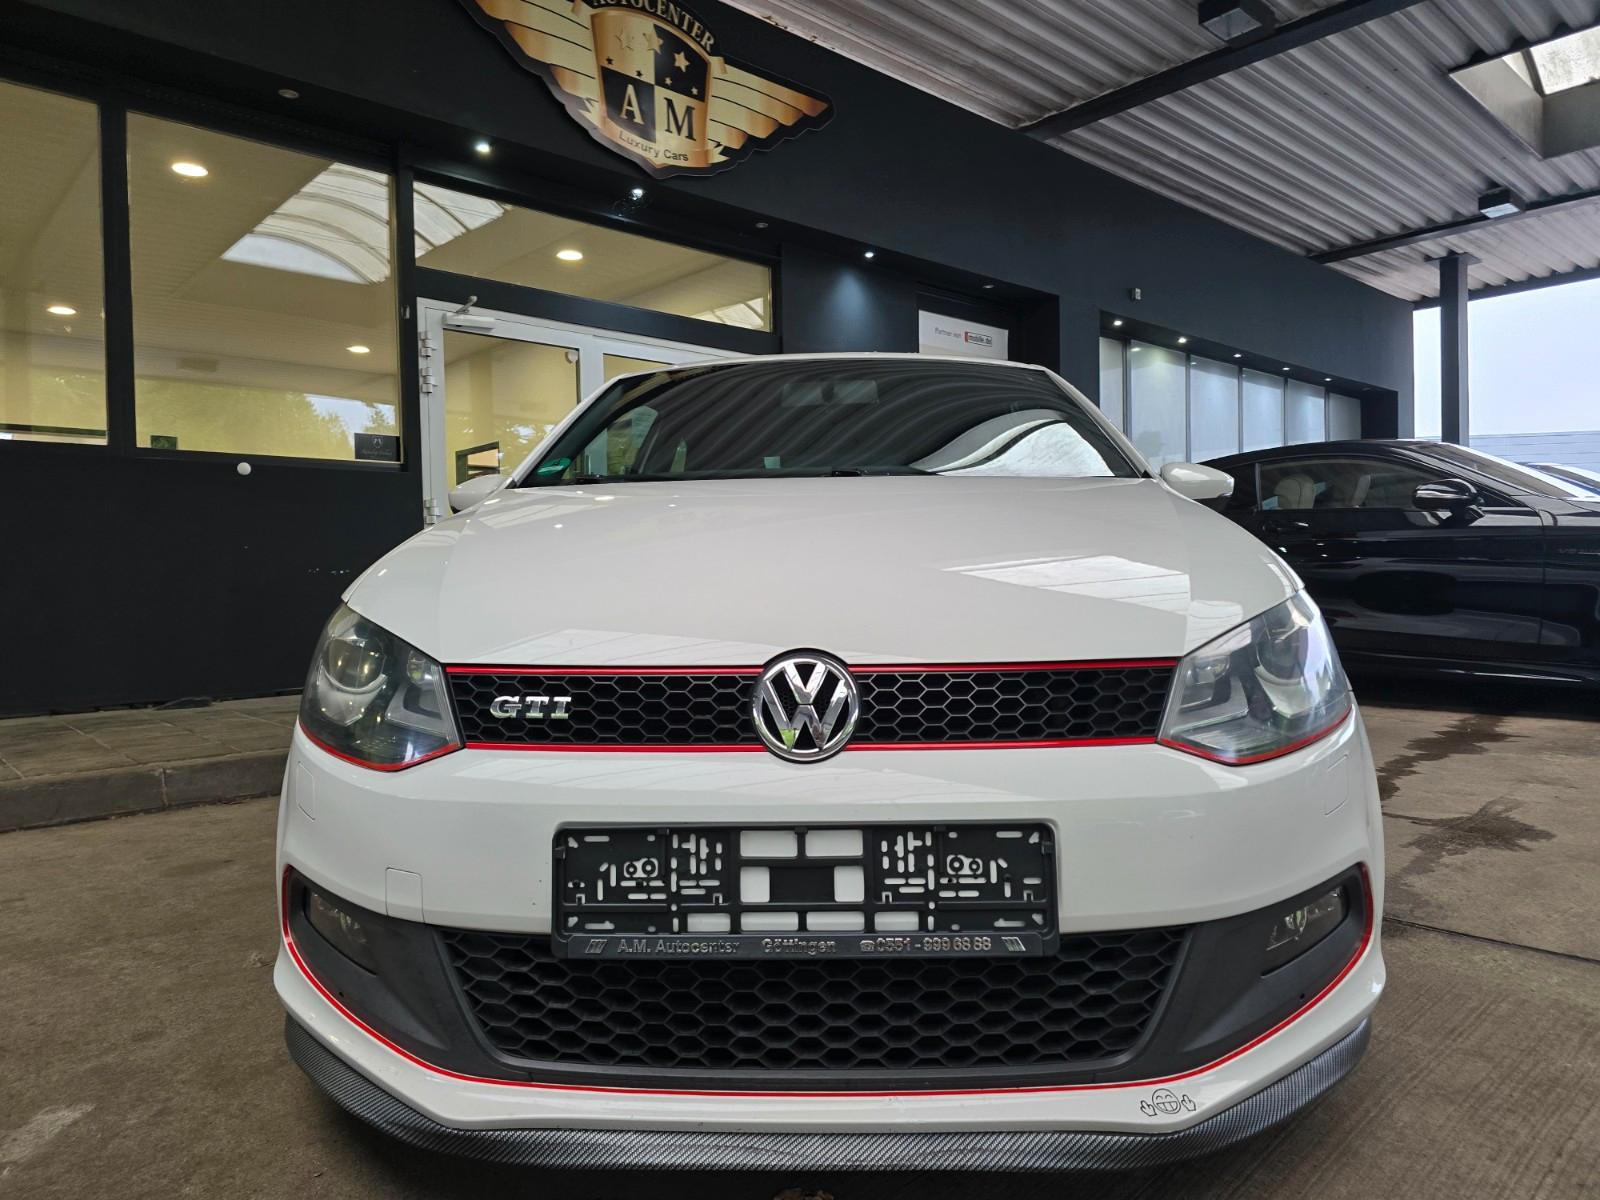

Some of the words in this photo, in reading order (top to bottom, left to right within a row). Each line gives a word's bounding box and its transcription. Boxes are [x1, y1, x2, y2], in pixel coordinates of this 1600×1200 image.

[593, 0, 715, 52] OCENTER
[620, 84, 645, 125] A
[663, 97, 697, 142] M
[619, 130, 660, 158] Luxury
[663, 149, 689, 162] Cars
[489, 695, 572, 721] GTI
[617, 938, 651, 953] A.M.
[655, 938, 740, 953] Autocenter
[762, 938, 836, 955] Göttingen
